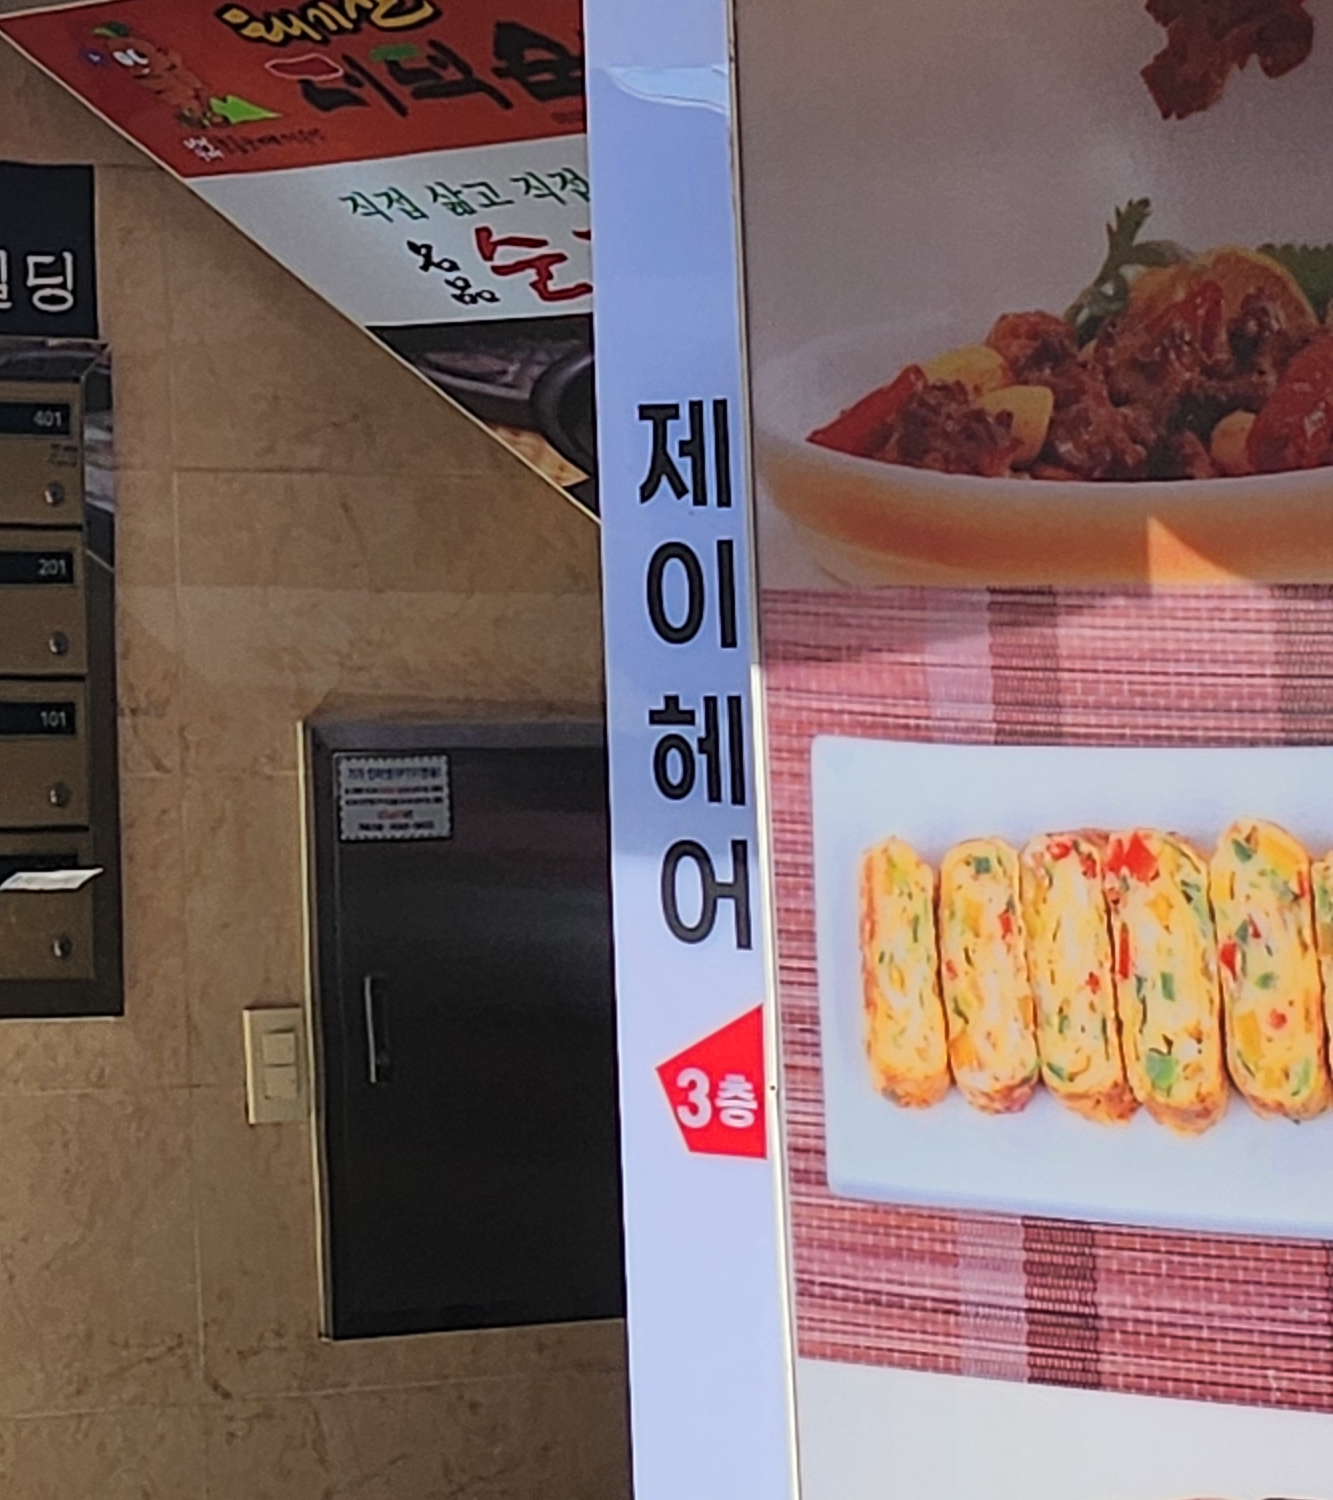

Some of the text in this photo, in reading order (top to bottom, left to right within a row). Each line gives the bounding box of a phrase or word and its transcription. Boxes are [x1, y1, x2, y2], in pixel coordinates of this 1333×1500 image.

[340, 186, 429, 223] 직접
[426, 181, 514, 217] 삶고
[474, 225, 593, 302] 순
[33, 409, 62, 428] 401
[37, 558, 66, 576] 201
[637, 398, 754, 951] 제이헤어
[40, 710, 67, 728] 101
[675, 1066, 759, 1130] 3층
